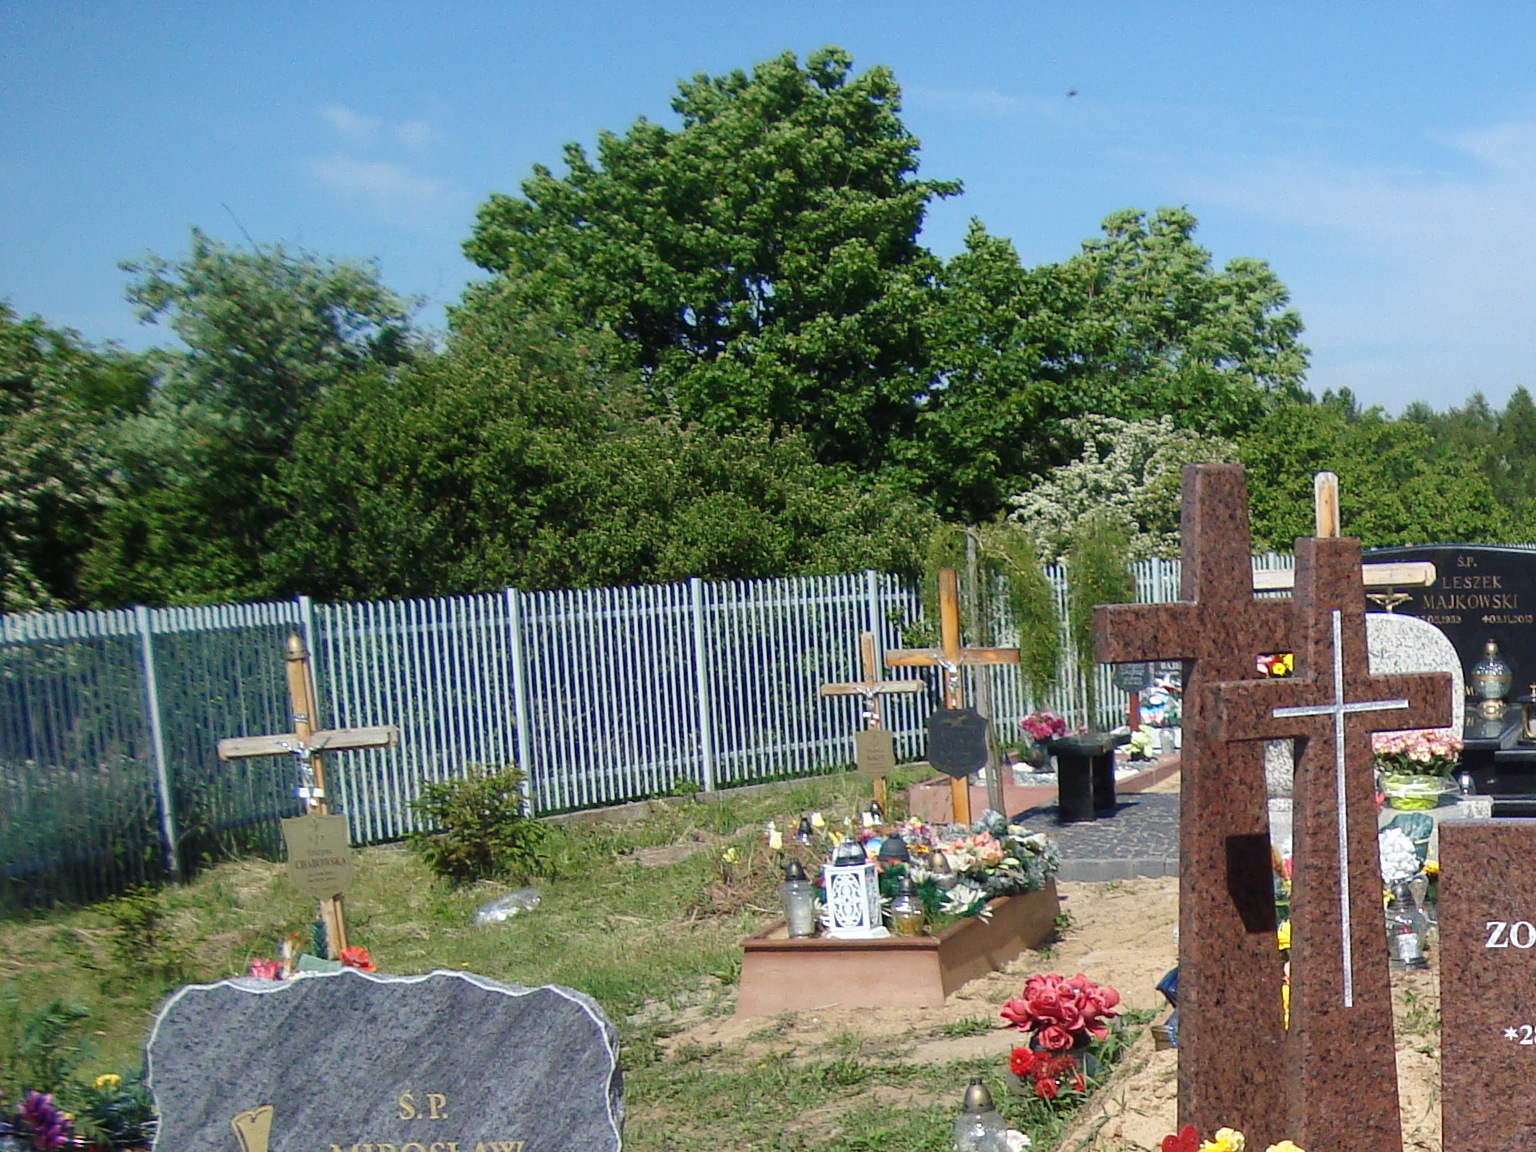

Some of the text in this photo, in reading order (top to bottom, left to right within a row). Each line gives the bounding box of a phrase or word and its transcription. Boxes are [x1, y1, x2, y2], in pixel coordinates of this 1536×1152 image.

[1457, 555, 1478, 568] Ś.P.
[1442, 576, 1503, 589] LESZEK
[1422, 594, 1519, 610] MAJKOWSKI
